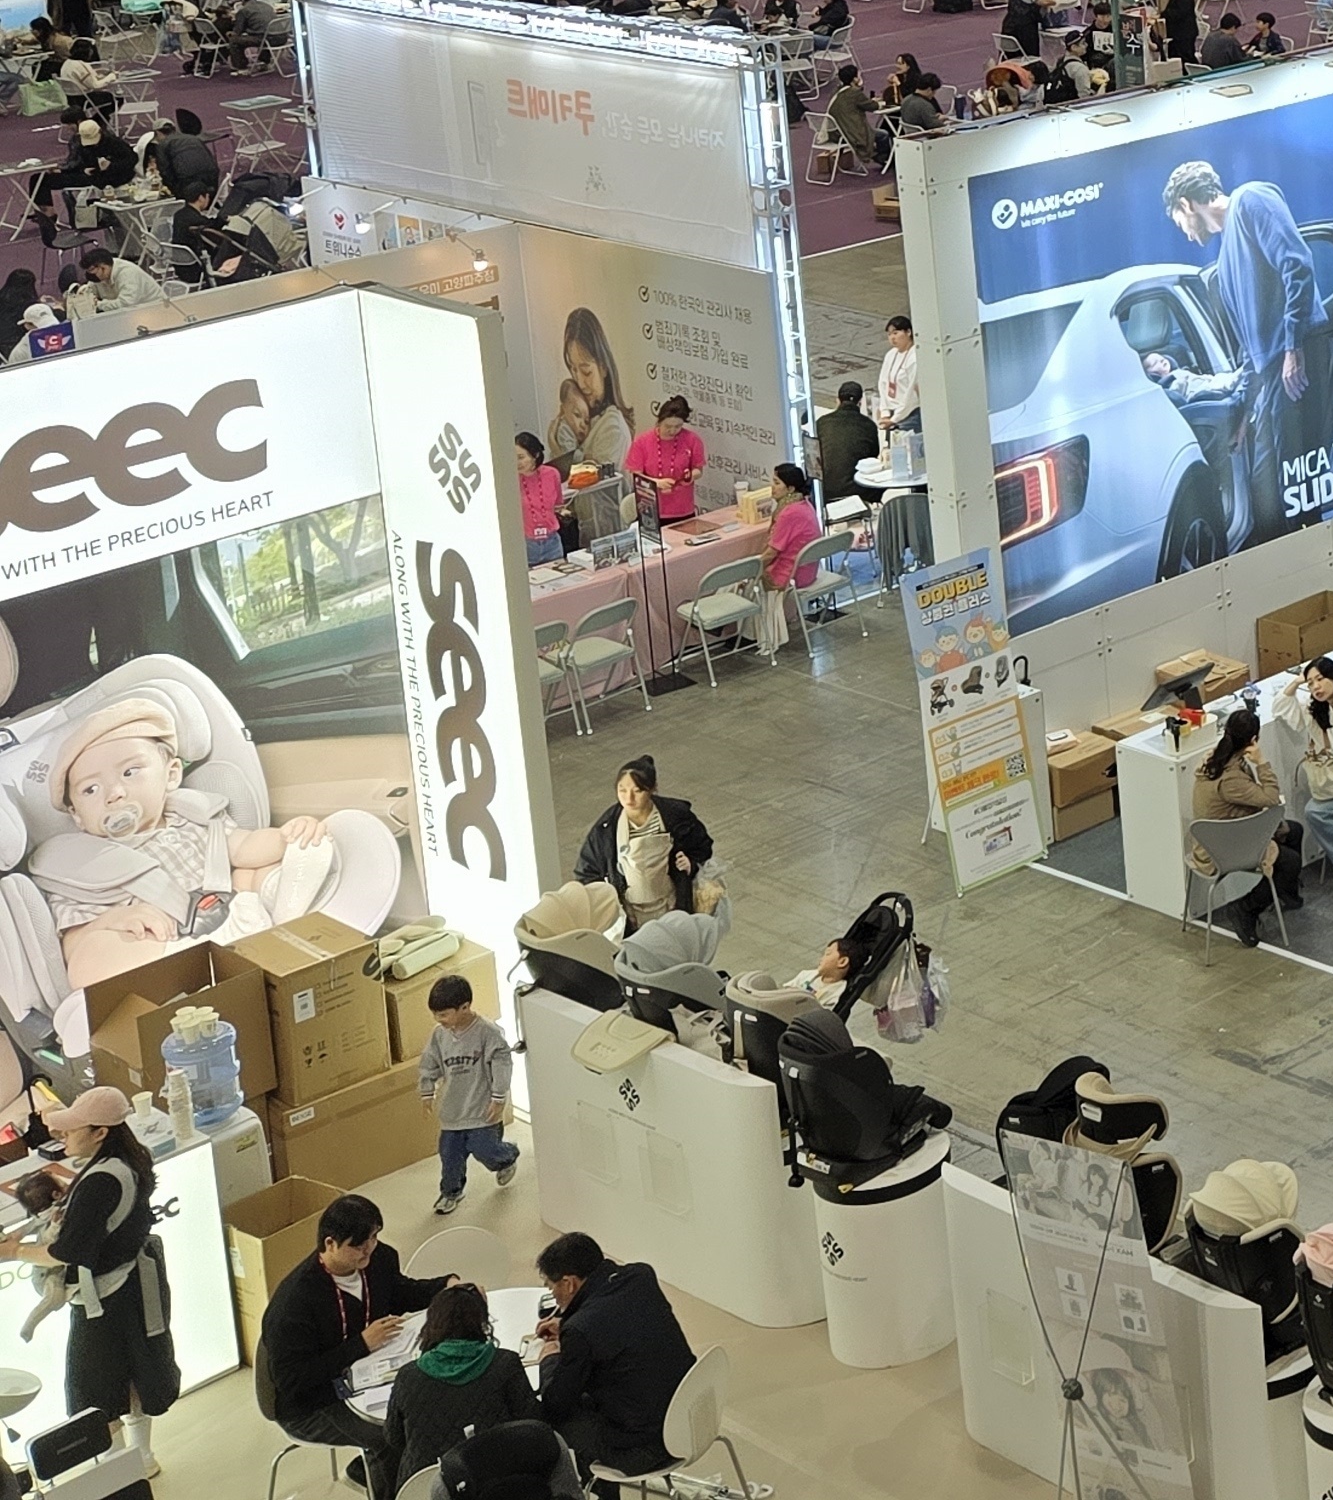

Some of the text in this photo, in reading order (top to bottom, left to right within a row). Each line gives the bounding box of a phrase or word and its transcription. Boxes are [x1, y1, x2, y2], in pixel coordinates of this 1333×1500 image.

[1031, 215, 1046, 227] carry
[1047, 212, 1057, 222] the
[1057, 208, 1077, 219] future
[442, 269, 495, 293] 고양파주점
[653, 290, 753, 325] 100% 한국인 관리사 채용
[655, 319, 722, 347] 범죄기록 조회 및
[711, 346, 729, 364] 가입
[731, 351, 750, 369] 완료
[661, 365, 754, 402] 철저한 건강진단서 확인
[759, 426, 776, 446] 관리
[0, 379, 269, 534] eec
[707, 453, 771, 484] 산후관리 서비스
[1282, 446, 1331, 487] MICA
[1, 490, 276, 580] WITH THE PRECIOUS HEART
[916, 575, 990, 610] DOUBLE
[391, 529, 439, 857] ALONG WITH THE PRECIOUS HEART
[415, 539, 508, 883] seec
